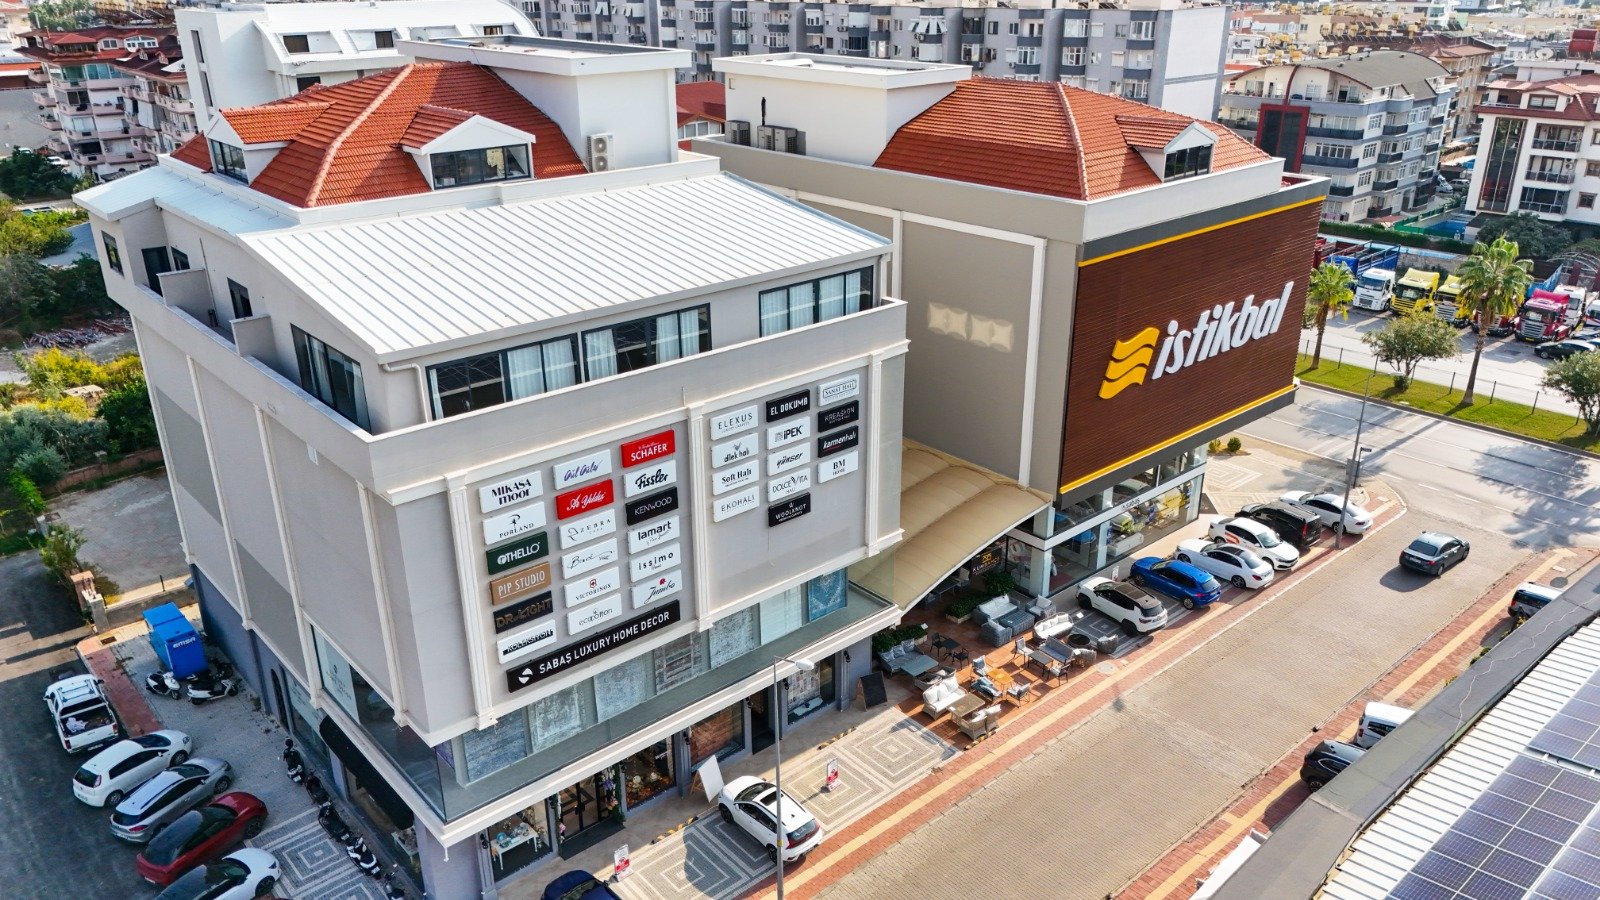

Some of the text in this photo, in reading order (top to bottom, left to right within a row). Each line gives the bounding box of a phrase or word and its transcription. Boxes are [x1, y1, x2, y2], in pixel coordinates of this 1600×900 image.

[1151, 280, 1295, 380] istikbal
[770, 397, 808, 416] EL DOKUMA
[718, 412, 753, 430] ELEXUS
[833, 459, 846, 470] BM
[491, 478, 532, 497] MIKASA
[635, 468, 669, 490] Fissler
[721, 473, 736, 483] Soft
[772, 480, 791, 493] DOLCE
[634, 496, 673, 516] KENWOOD
[499, 523, 535, 538] PORLAND
[637, 520, 672, 541] lamart
[497, 543, 541, 565] OTHELLO
[638, 552, 674, 571] issimo
[498, 570, 546, 596] PIP STUDIO
[575, 583, 612, 600] VICTORINOX
[539, 611, 670, 674] SABAŞ LUXURY HOME DECOR
